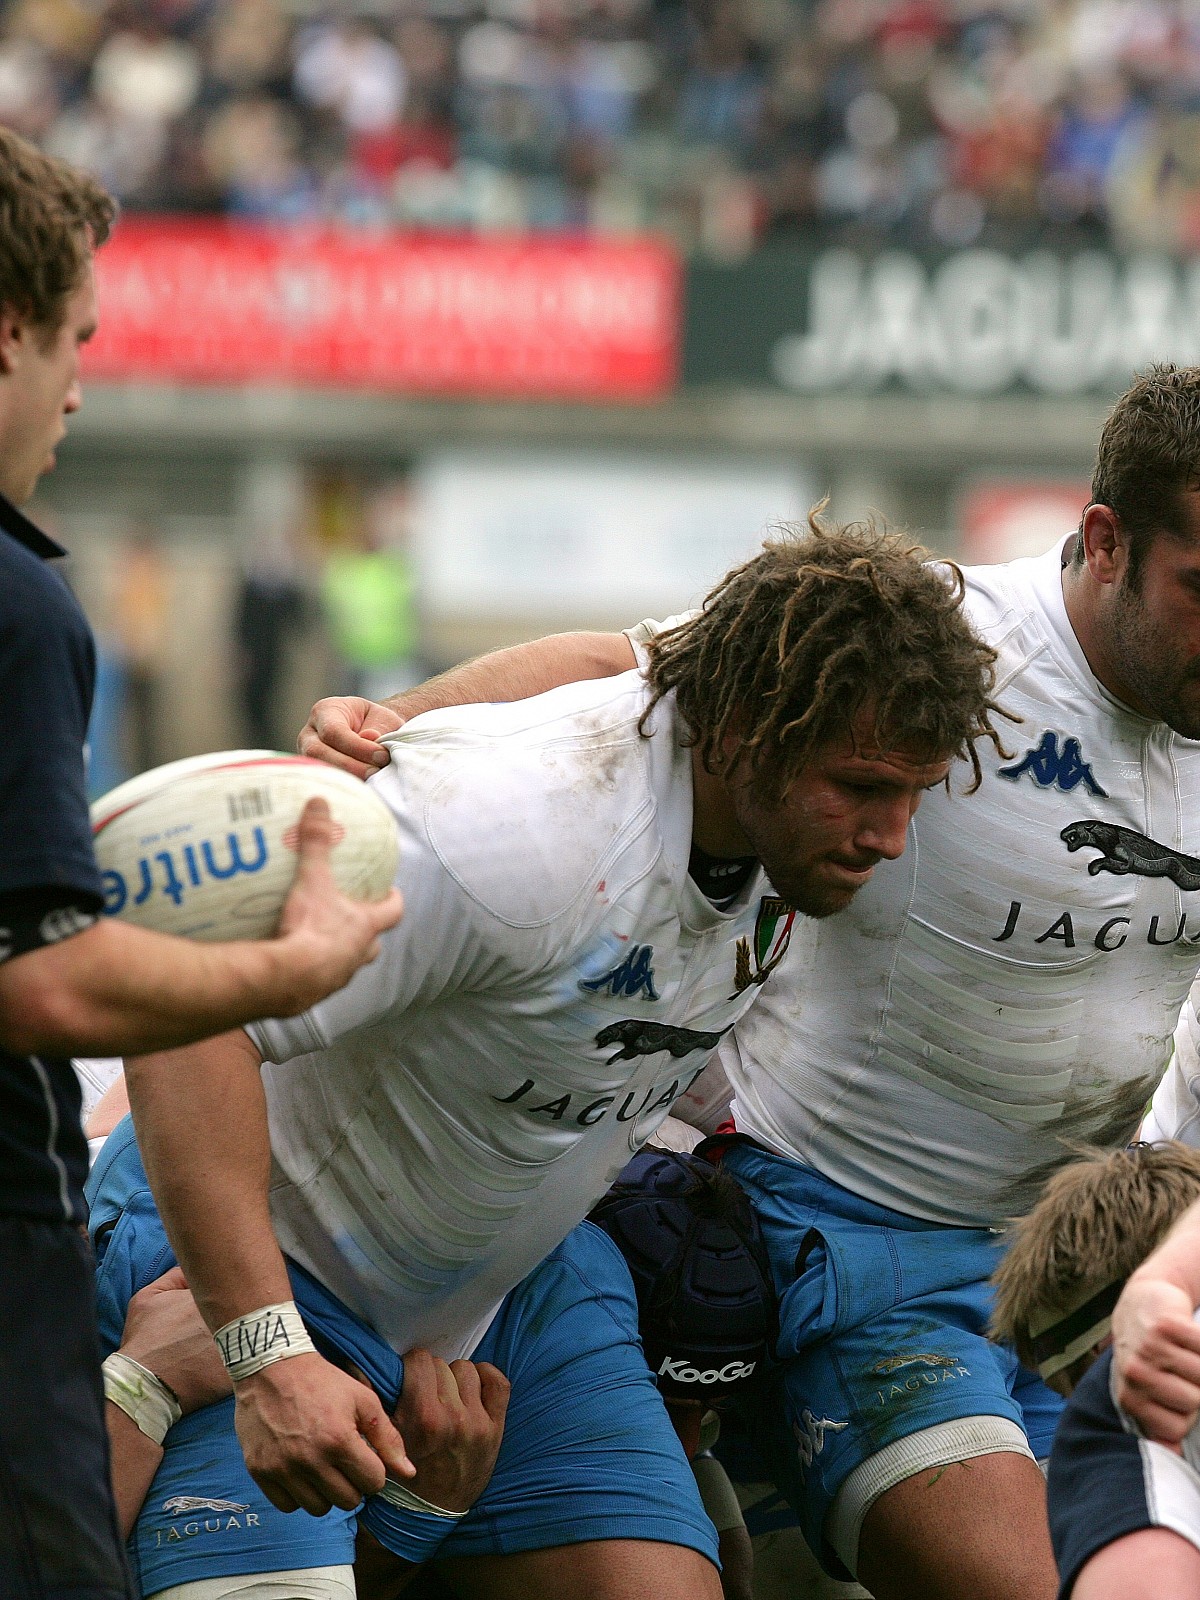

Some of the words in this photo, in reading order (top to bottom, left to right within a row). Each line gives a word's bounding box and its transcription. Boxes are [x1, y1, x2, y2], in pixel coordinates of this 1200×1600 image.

[100, 826, 269, 916] mitre
[492, 1064, 708, 1126] JAGUA
[876, 1365, 973, 1405] JAGUAR
[155, 1512, 261, 1548] JAGUAR
